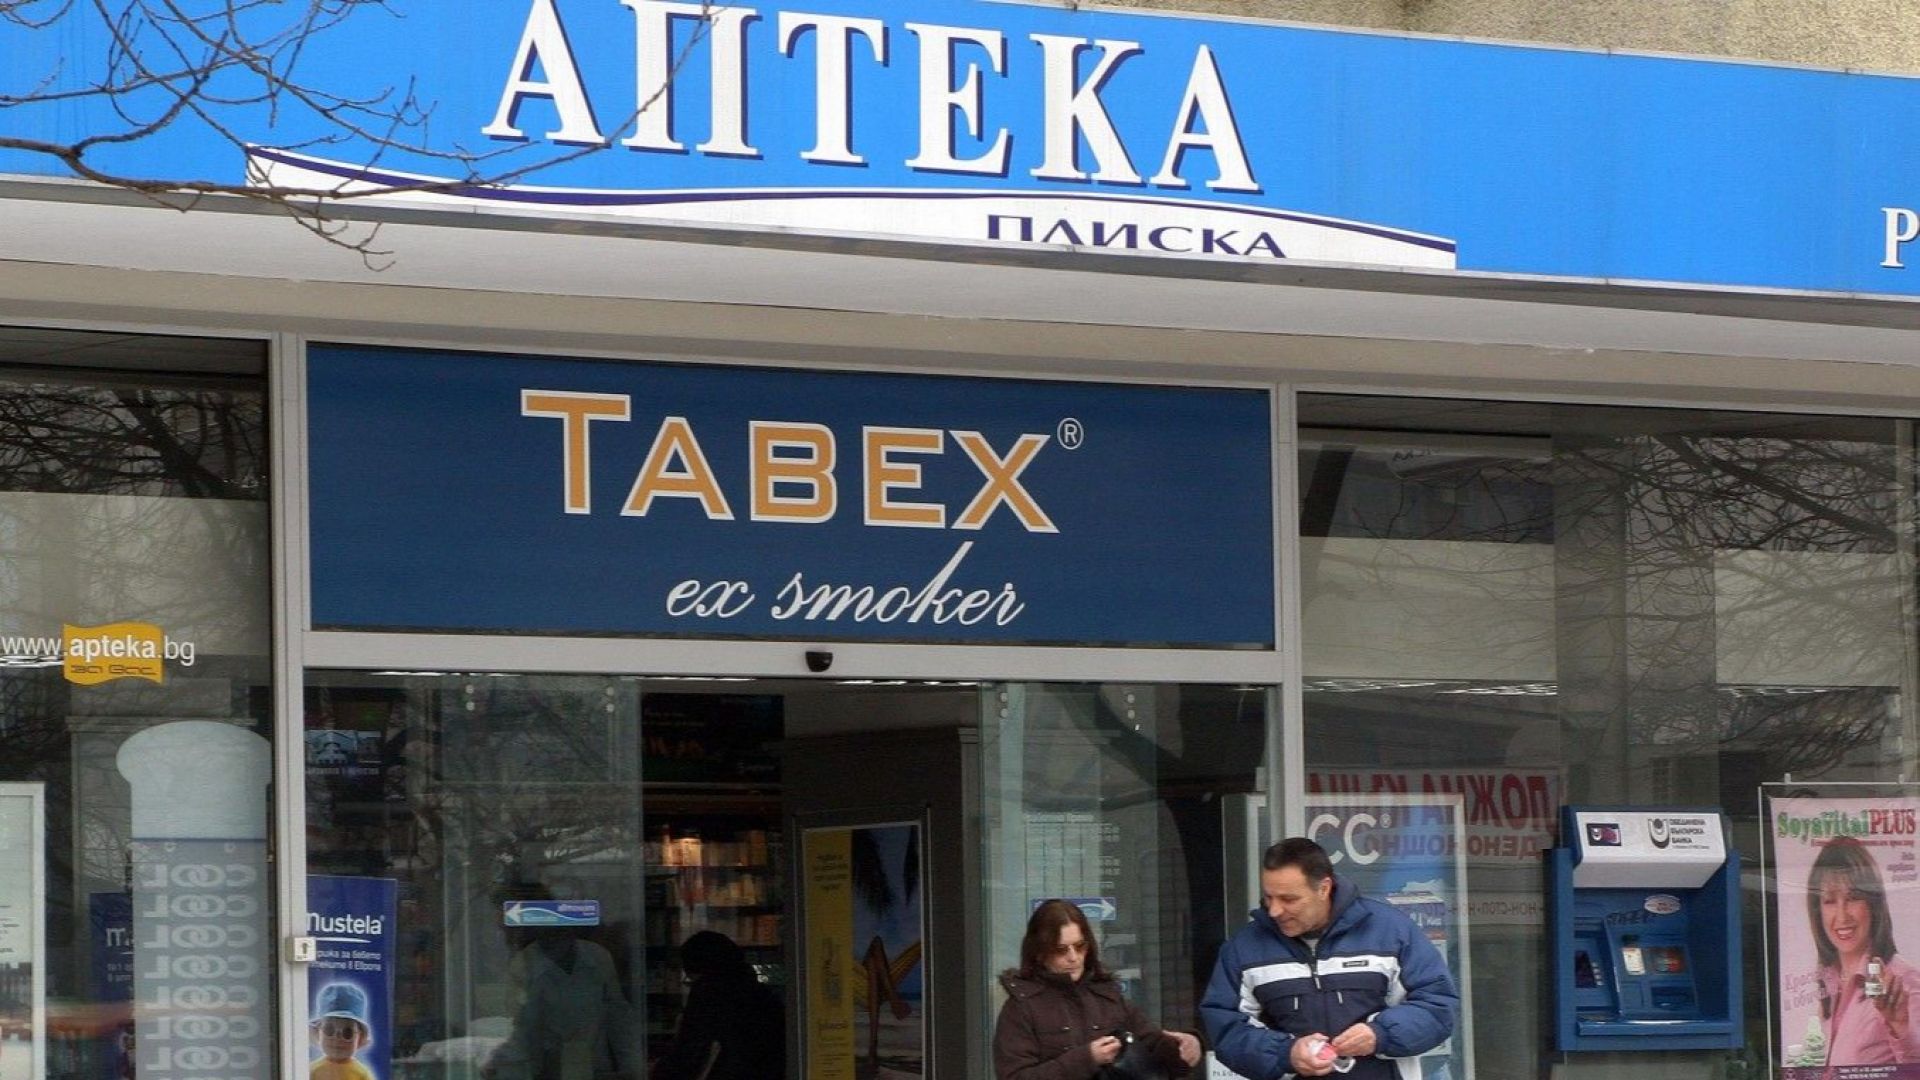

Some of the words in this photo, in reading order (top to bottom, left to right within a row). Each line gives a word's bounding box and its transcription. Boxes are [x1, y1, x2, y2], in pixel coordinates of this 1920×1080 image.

[482, 0, 1263, 195] АПТЕКА
[988, 214, 1286, 259] ПЛИСКА
[666, 577, 755, 617] ex
[771, 541, 1025, 626] smoker
[2, 635, 195, 666] www.apteka.bg
